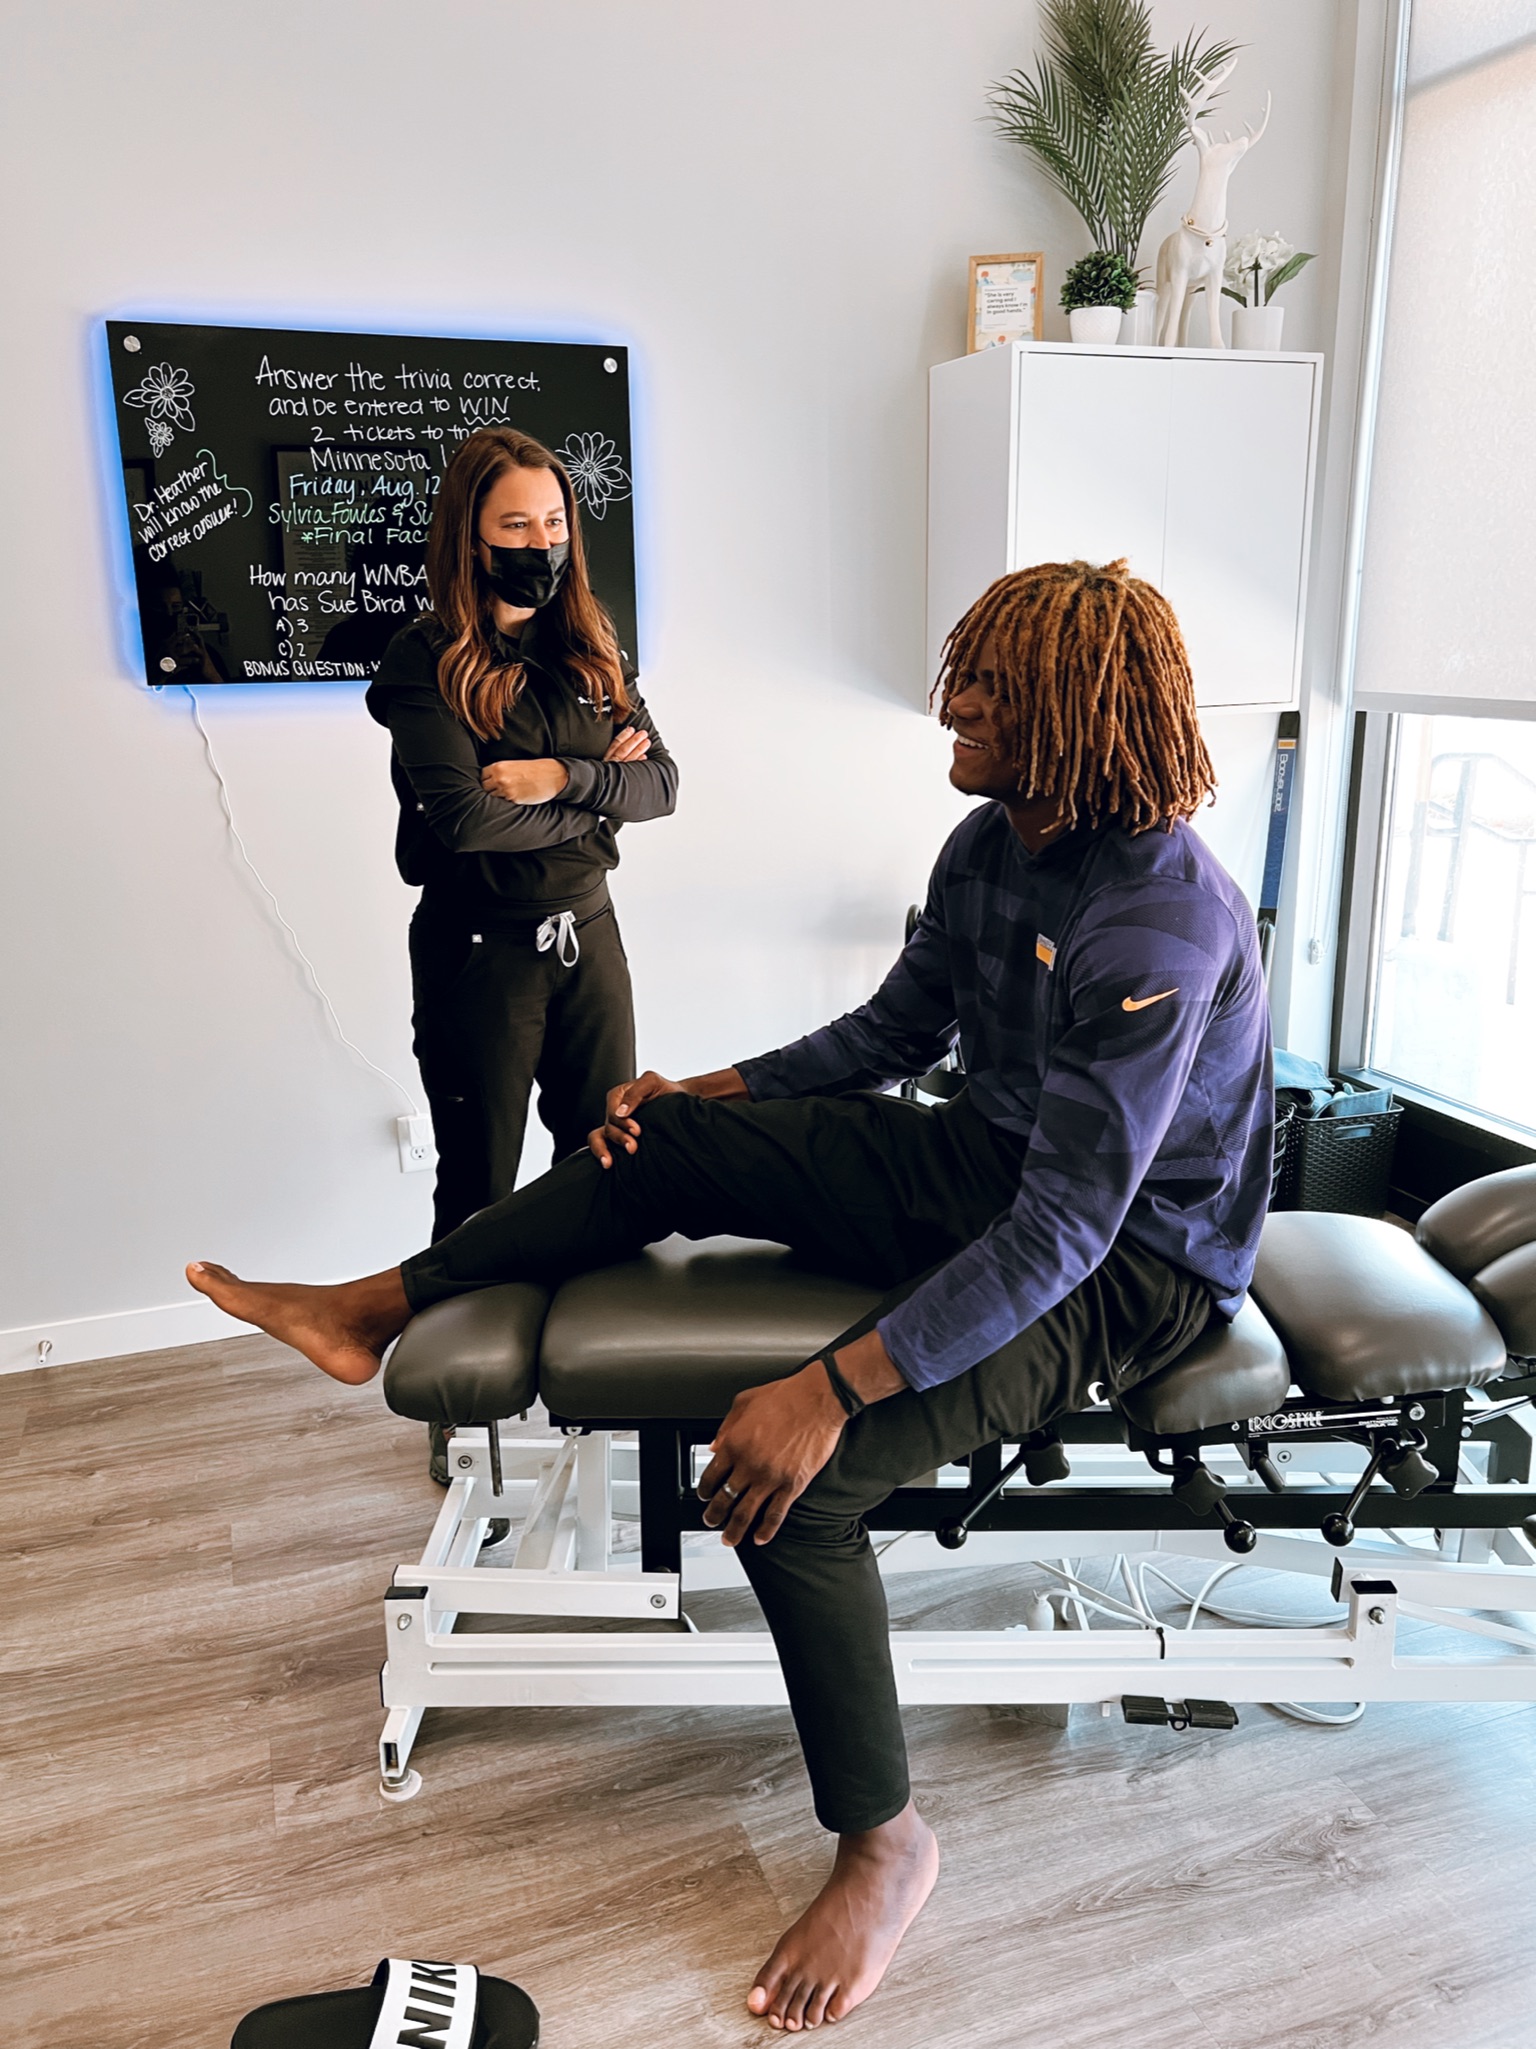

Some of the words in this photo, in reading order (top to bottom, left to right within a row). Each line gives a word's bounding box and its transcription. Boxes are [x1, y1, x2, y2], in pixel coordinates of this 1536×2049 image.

[255, 355, 338, 390] Answer
[344, 362, 386, 392] the
[394, 363, 453, 390] trivia
[269, 397, 308, 416] and
[344, 399, 424, 417] entered
[429, 396, 450, 413] to
[459, 396, 509, 416] WIN
[311, 426, 335, 442] 2
[343, 423, 416, 441] tickets
[421, 424, 443, 440] to
[446, 424, 483, 440] th
[310, 446, 431, 473] Minnesota
[133, 501, 159, 522] Dr.
[153, 462, 208, 505] Heather
[289, 474, 366, 505] Friday,
[371, 475, 420, 508] Aug.
[425, 475, 441, 495] 12
[138, 516, 163, 544] will
[160, 495, 200, 527] know
[197, 482, 222, 502] the
[268, 502, 331, 532] Sylvia
[331, 501, 387, 525] Fowles
[409, 500, 434, 527] Su
[148, 528, 192, 562] correct
[250, 564, 287, 587] How
[294, 571, 356, 598] many
[363, 563, 430, 587] WNBA
[268, 591, 309, 612] has
[317, 590, 359, 613] Sue
[361, 589, 406, 613] Bird
[276, 616, 294, 637] A)
[296, 618, 309, 633] 3
[278, 639, 294, 659] C)
[296, 643, 306, 657] 2
[243, 660, 291, 677] BONUS
[292, 660, 371, 677] QUESTION:
[396, 1959, 457, 2049] NIK
